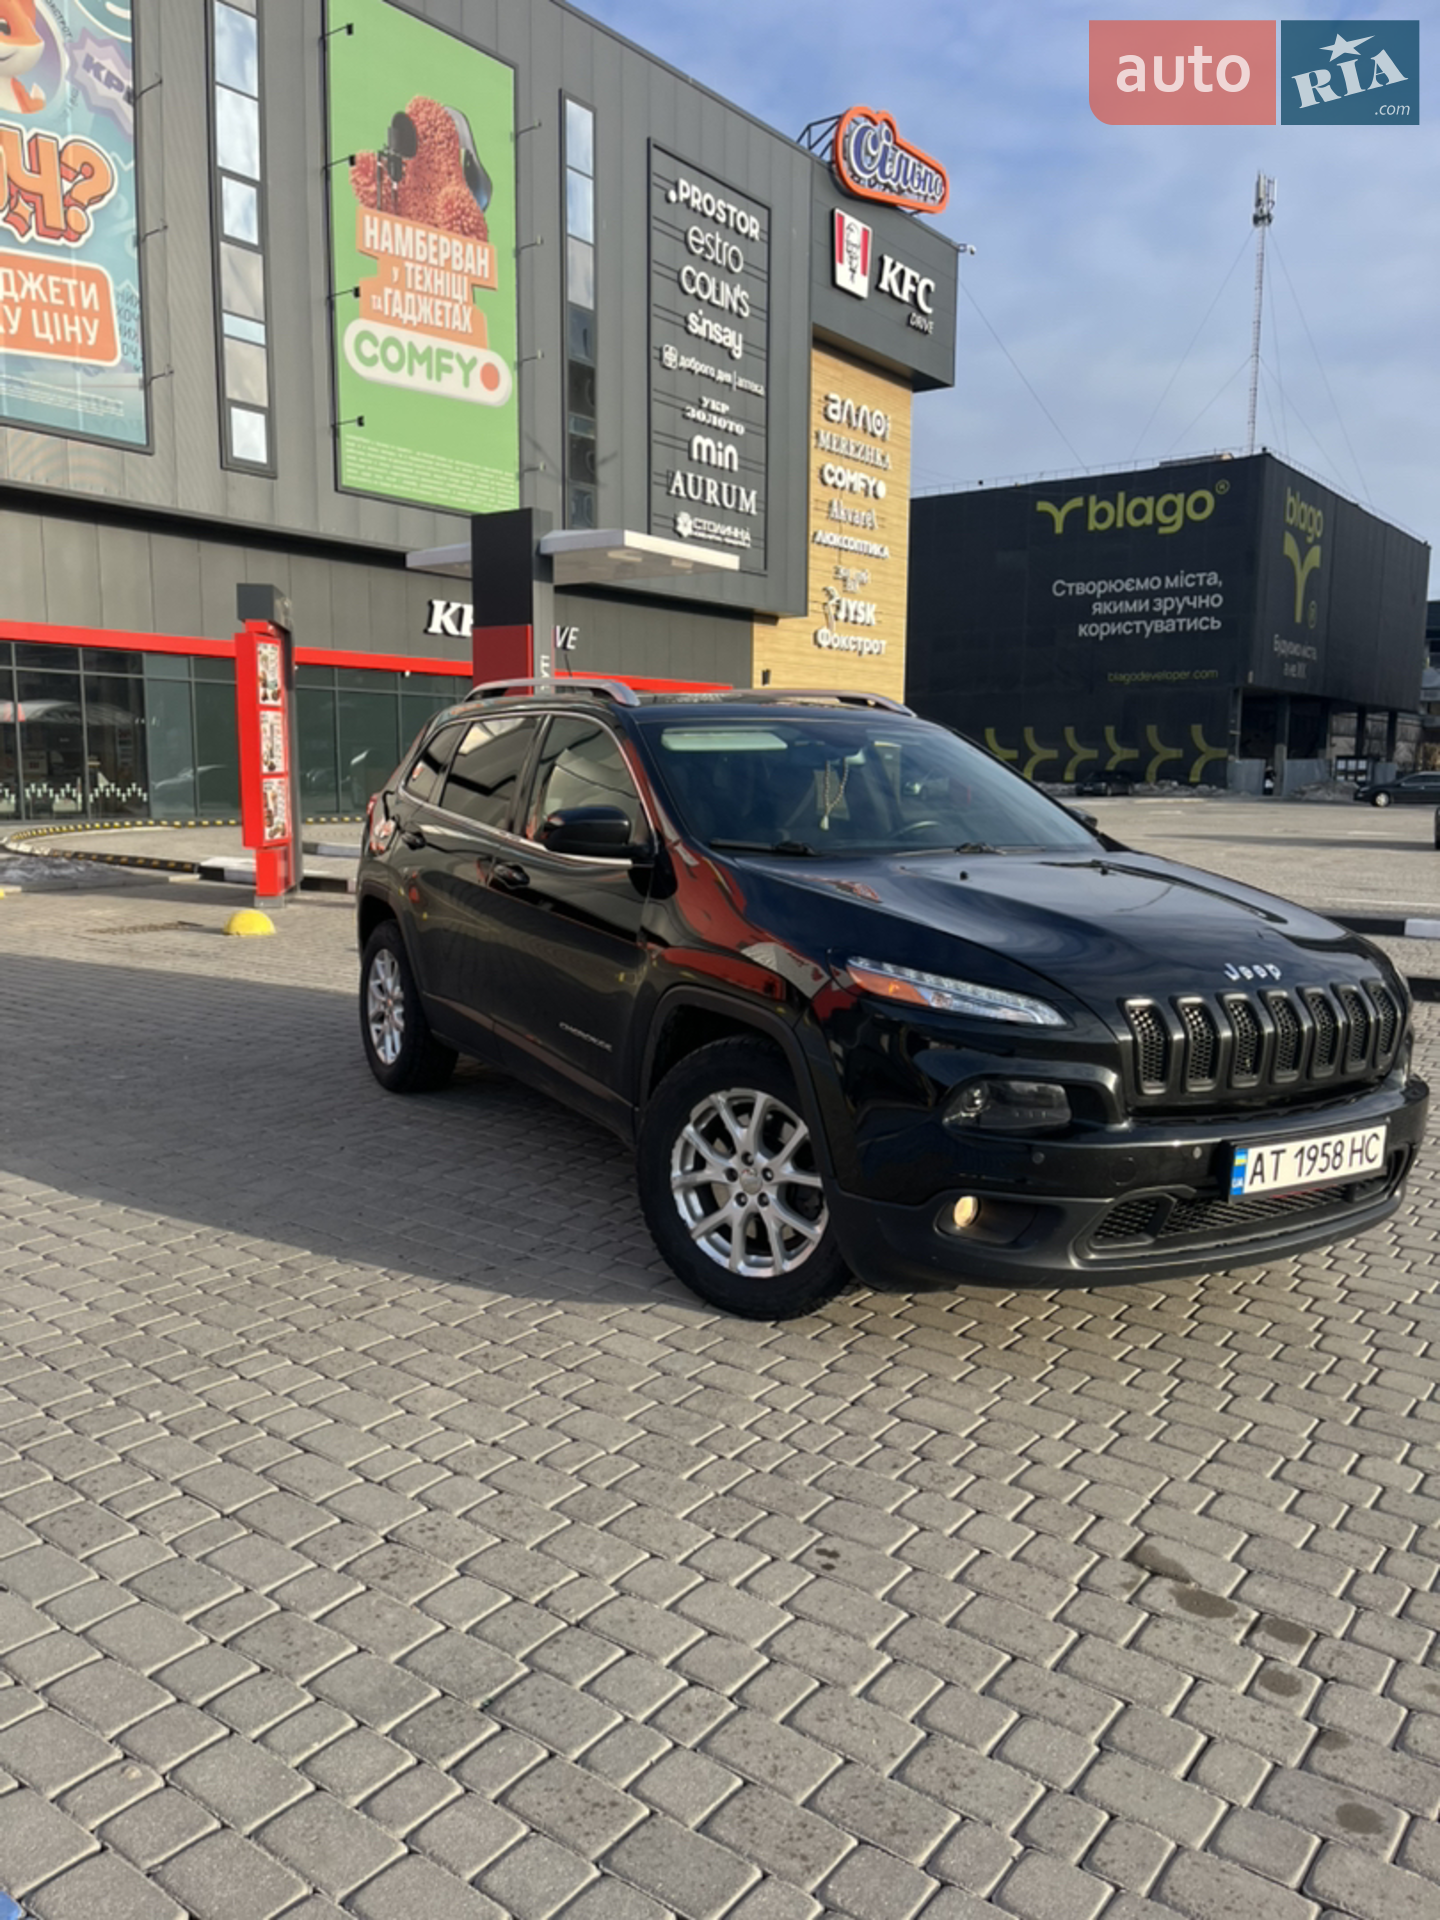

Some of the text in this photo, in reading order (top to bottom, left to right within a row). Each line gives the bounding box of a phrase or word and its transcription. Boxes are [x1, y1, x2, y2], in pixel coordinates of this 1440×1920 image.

[851, 124, 944, 198] Сільпо
[364, 215, 490, 279] НАМБЕРВАН
[687, 226, 744, 273] estro
[404, 262, 468, 305] ТЕХНІЦІ
[681, 265, 750, 318] COLIN'S
[878, 254, 936, 315] KFC
[31, 308, 100, 346] ЦІНУ
[383, 287, 474, 334] ГАДЖЕТАХ
[687, 309, 744, 360] sinsay
[354, 329, 478, 389] COMFY
[685, 406, 745, 436] ЗОЛОТО
[692, 434, 739, 472] min
[670, 470, 758, 516] AURUM
[1284, 486, 1324, 544] blago
[1052, 570, 1223, 599] Створюємо міста,
[1091, 593, 1224, 616] якими зручно
[837, 598, 876, 626] JYSK
[1078, 616, 1223, 641] користуватись
[1224, 963, 1282, 981] Jeep
[1249, 1132, 1380, 1186] AT 1958 HC
